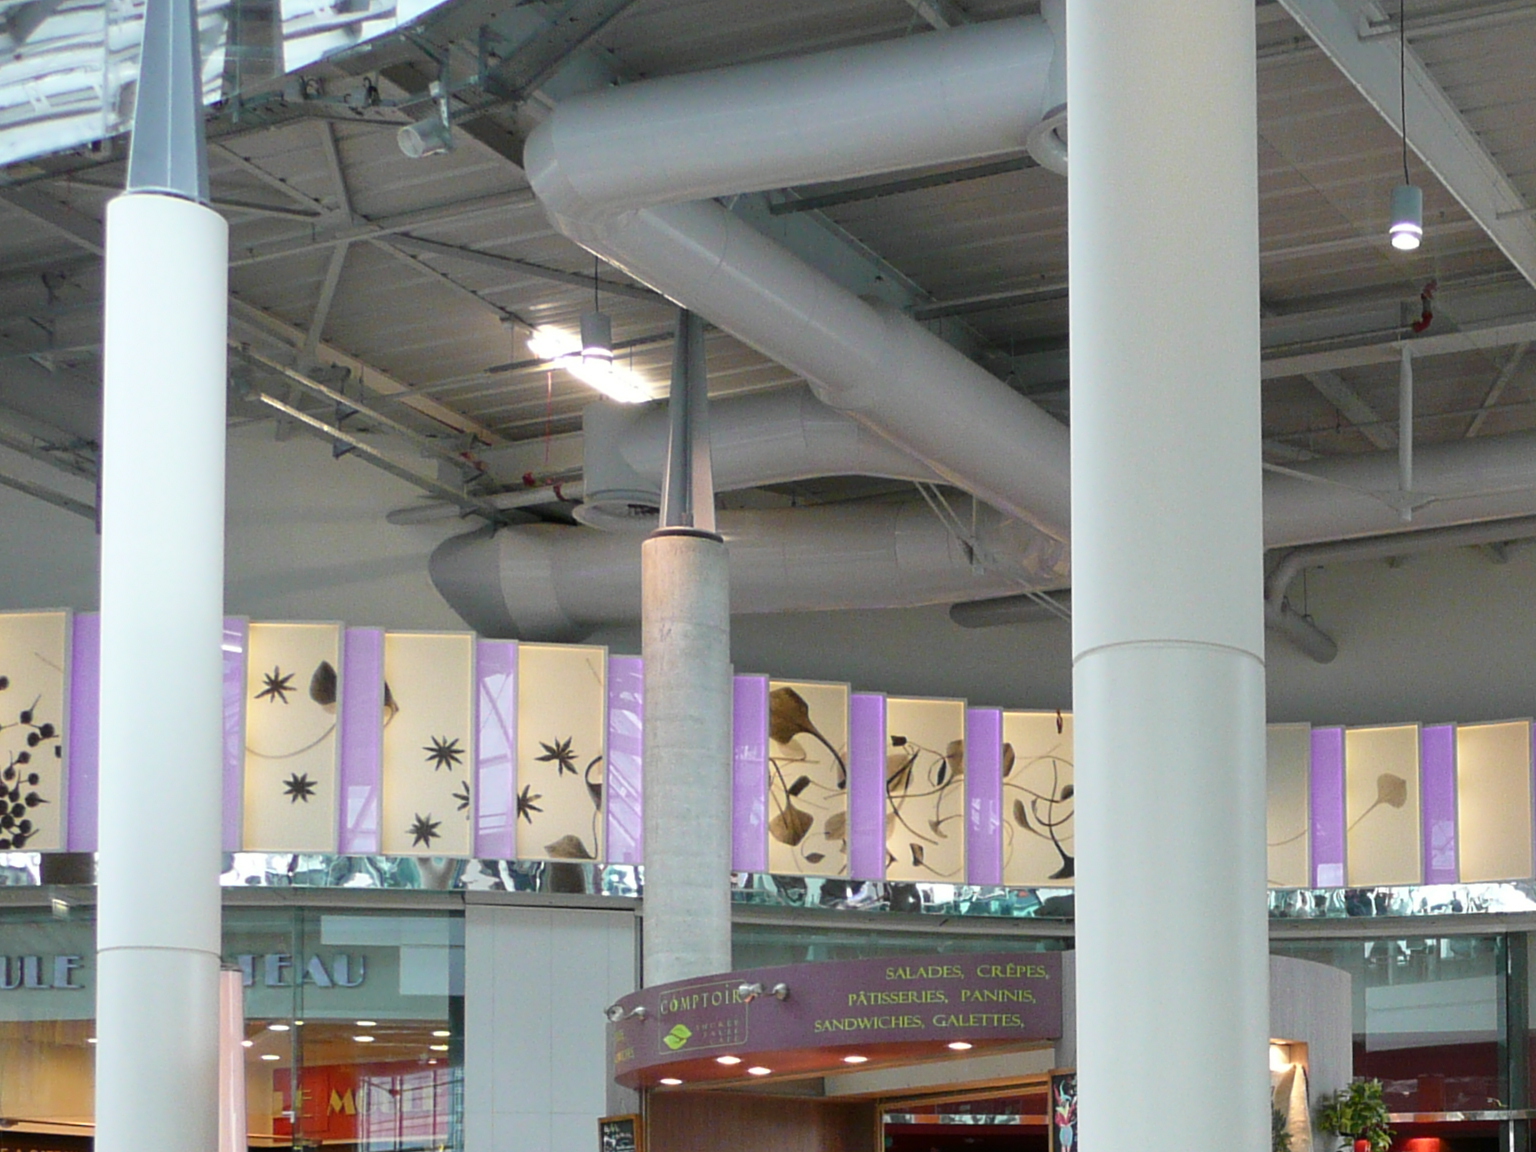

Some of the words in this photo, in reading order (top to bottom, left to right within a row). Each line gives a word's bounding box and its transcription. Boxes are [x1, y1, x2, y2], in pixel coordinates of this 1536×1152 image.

[885, 965, 965, 980] SALADES,
[976, 963, 1049, 980] CRÊPES,
[848, 989, 949, 1006] PÂTISSERIES,
[961, 988, 1037, 1004] PANINIS,
[814, 1014, 925, 1033] SANDWICHES,
[932, 1013, 1024, 1029] GALETTES,
